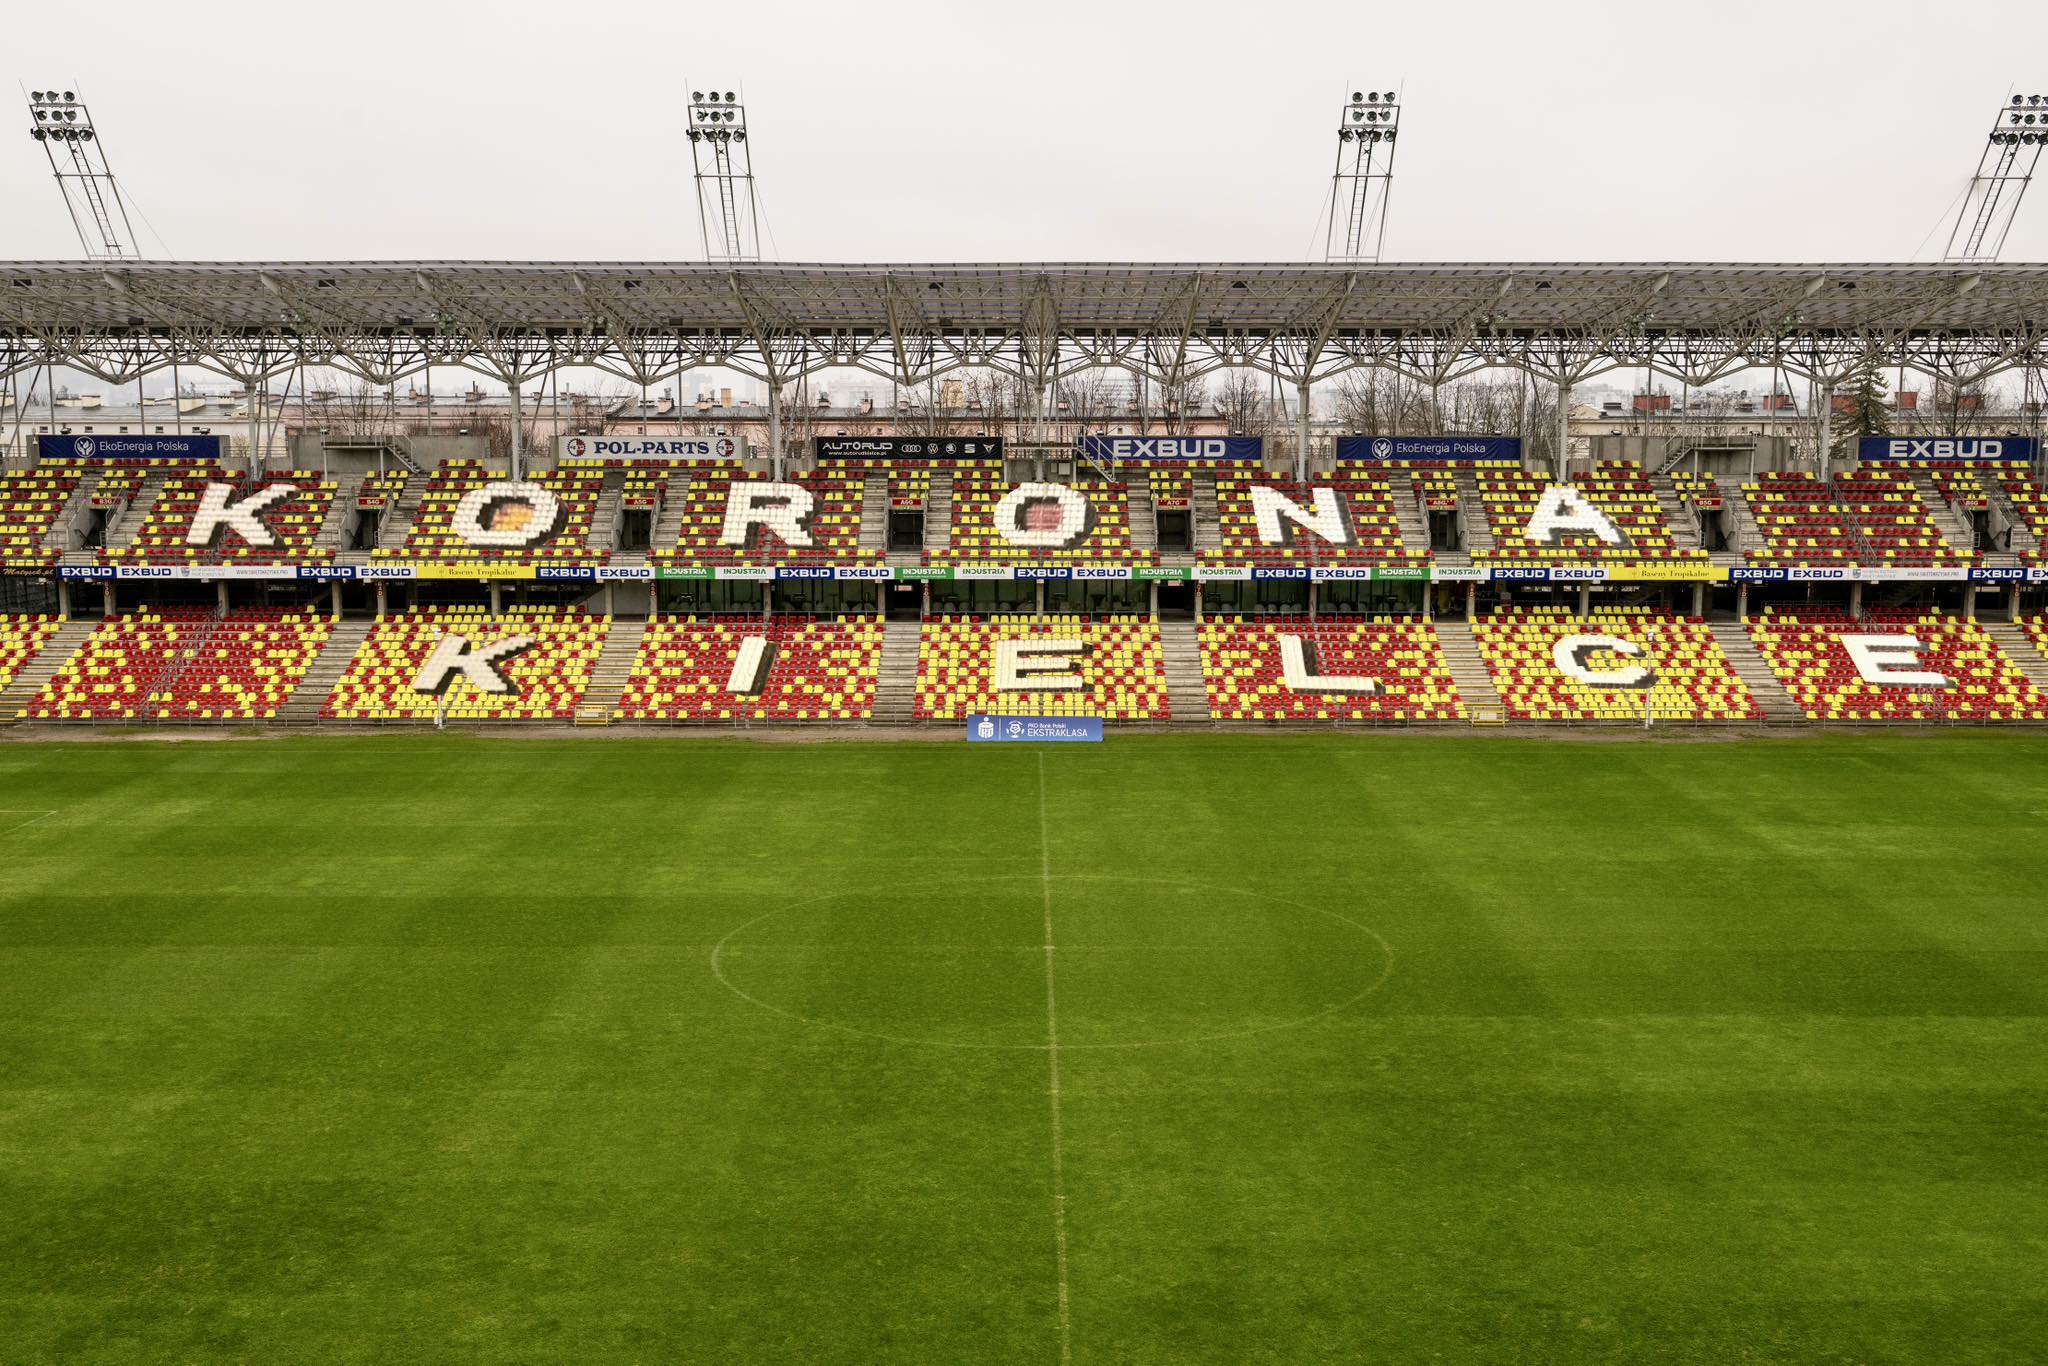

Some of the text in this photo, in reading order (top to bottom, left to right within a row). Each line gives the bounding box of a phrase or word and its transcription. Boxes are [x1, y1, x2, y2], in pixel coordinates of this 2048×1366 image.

[99, 441, 189, 453] EkoEnergia Polska
[594, 441, 710, 455] POL-PARTS
[822, 441, 893, 450] AUTORUD
[1113, 439, 1226, 457] EXBUD
[1396, 442, 1486, 455] EkoEnergia Polska
[1889, 440, 2003, 458] EXBUD
[62, 568, 112, 576] EXBUD
[122, 568, 171, 576] EXBUD
[302, 568, 351, 576] EXBUD
[449, 568, 517, 578] Baseny Tropikalne
[541, 569, 590, 577] EXBUD
[600, 569, 650, 577] EXBUD
[780, 569, 830, 577] EXBUD
[840, 569, 889, 577] EXBUD
[1018, 569, 1067, 577] EXBUD
[1077, 569, 1126, 577] EXBUD
[1641, 569, 1710, 579] Baseny Tropikalne
[1027, 729, 1088, 738] EKSTRAKLASA
